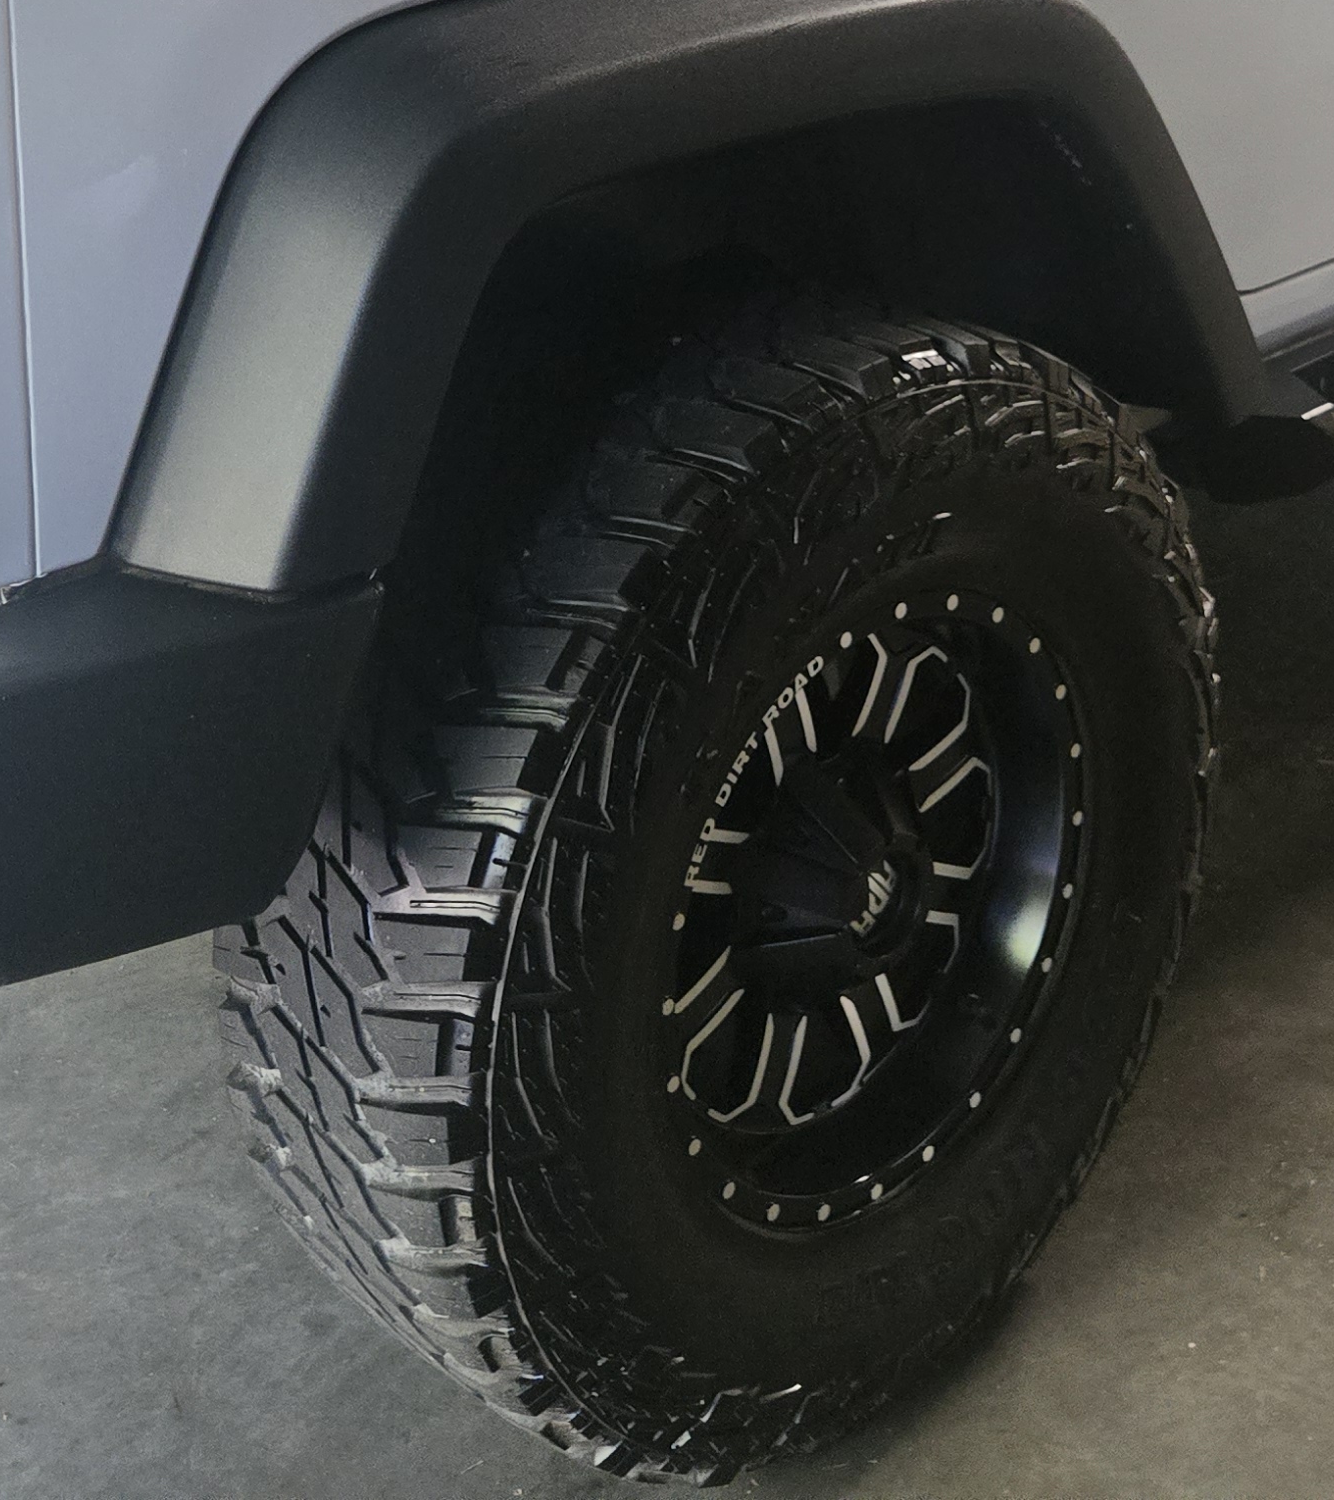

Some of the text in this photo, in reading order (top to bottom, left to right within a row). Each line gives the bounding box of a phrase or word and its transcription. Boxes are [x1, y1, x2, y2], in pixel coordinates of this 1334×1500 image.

[684, 656, 824, 887] RED DIRT ROAD
